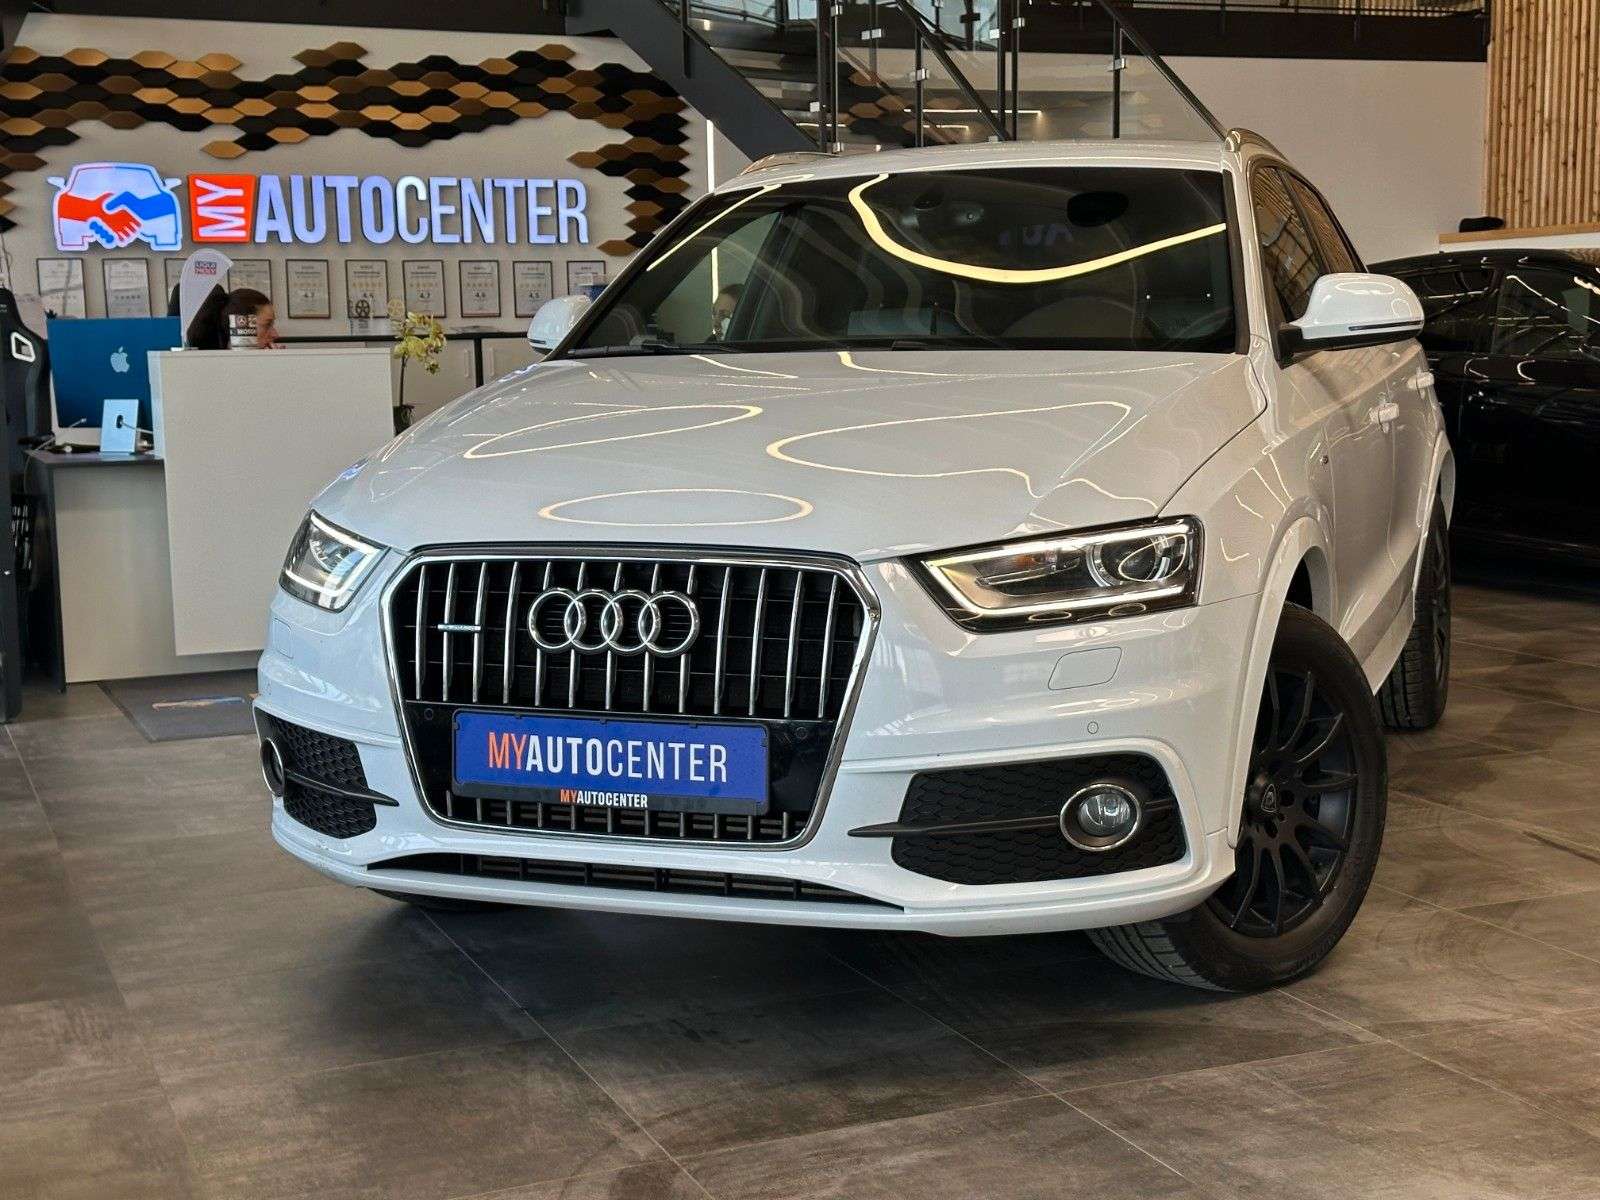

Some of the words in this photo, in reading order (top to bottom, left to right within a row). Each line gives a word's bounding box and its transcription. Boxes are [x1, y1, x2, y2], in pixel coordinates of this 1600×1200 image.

[195, 178, 247, 238] MY
[254, 174, 589, 244] AUTOCENTER
[488, 732, 728, 783] MYAUTOCENTER
[560, 788, 648, 808] MYAUTOCENTER
